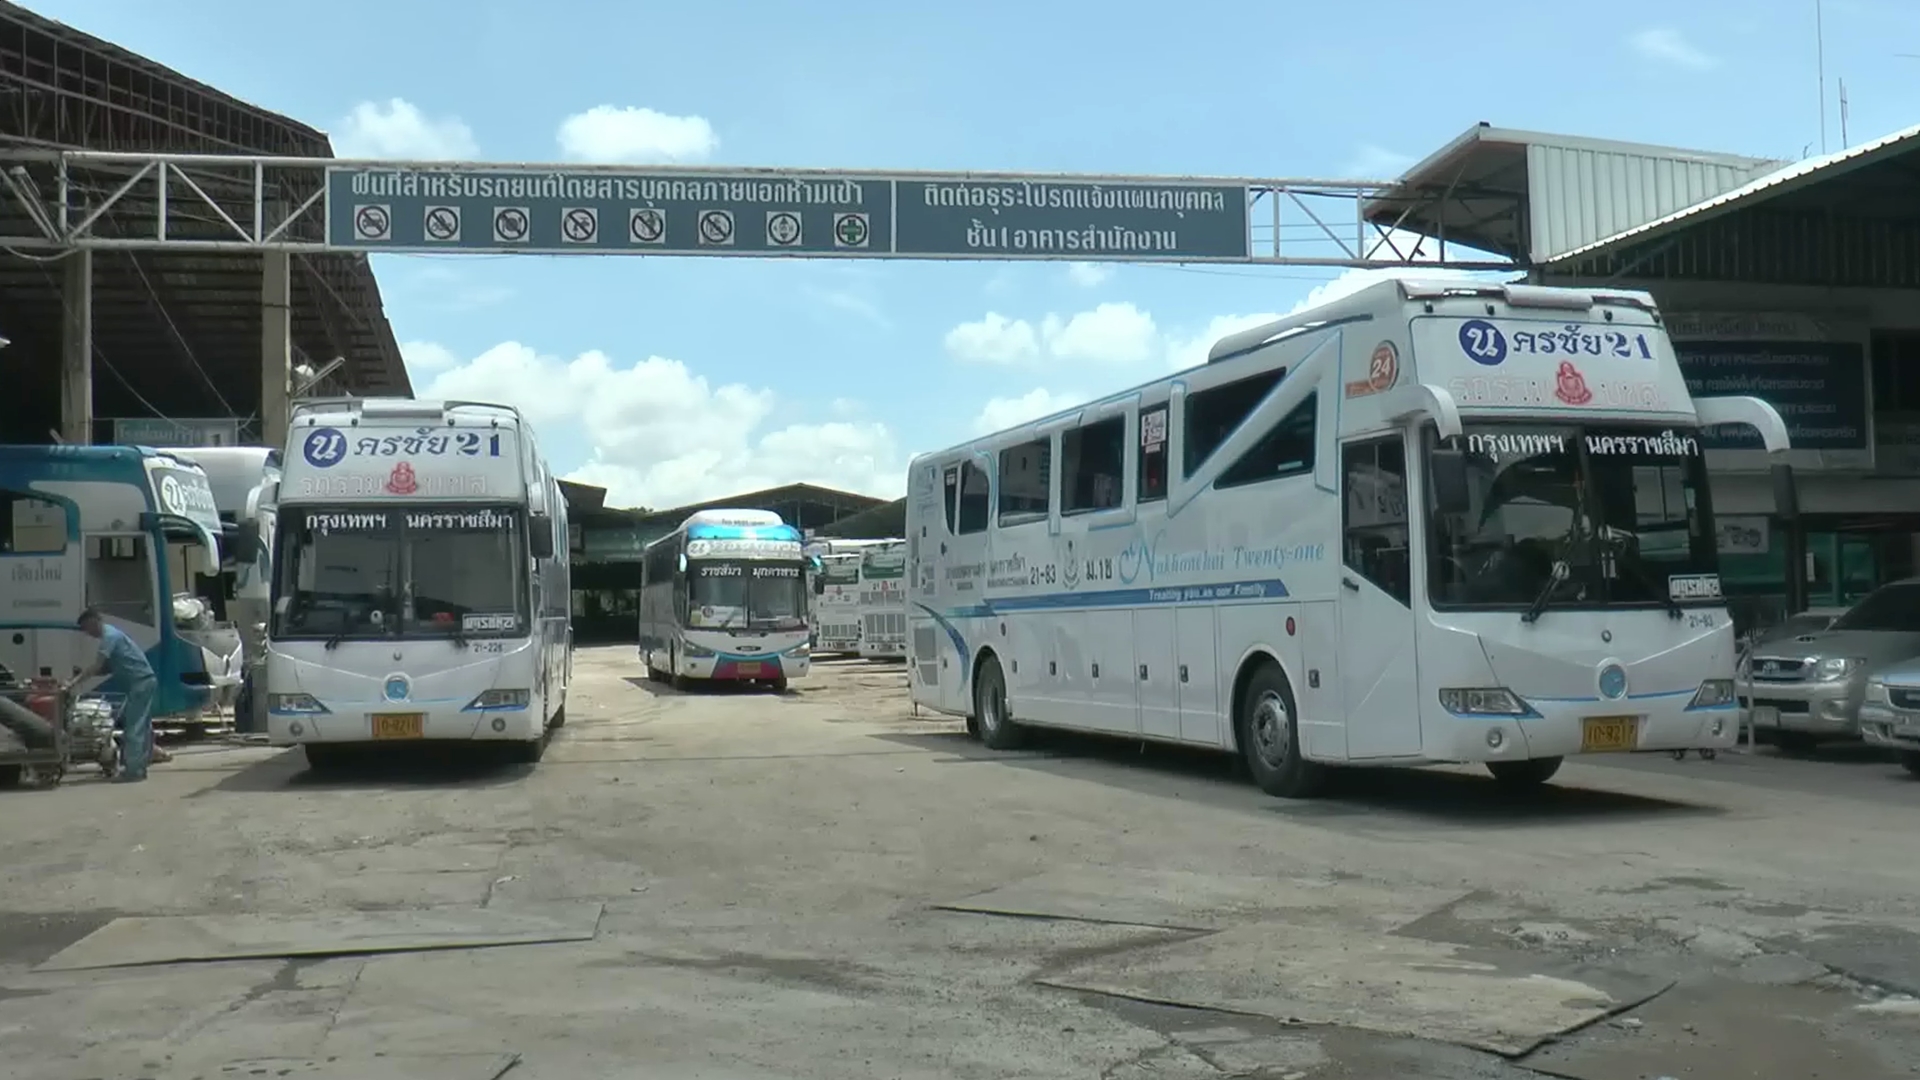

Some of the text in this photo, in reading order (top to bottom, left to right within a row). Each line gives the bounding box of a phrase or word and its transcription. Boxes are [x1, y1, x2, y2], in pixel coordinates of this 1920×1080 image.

[1467, 432, 1564, 462] กรุงเทพฯ
[1585, 429, 1699, 458] นครราชสีมา
[305, 508, 514, 536] กรุงเทพฯ นครราชสีมา
[1232, 541, 1326, 571] Twenty-one
